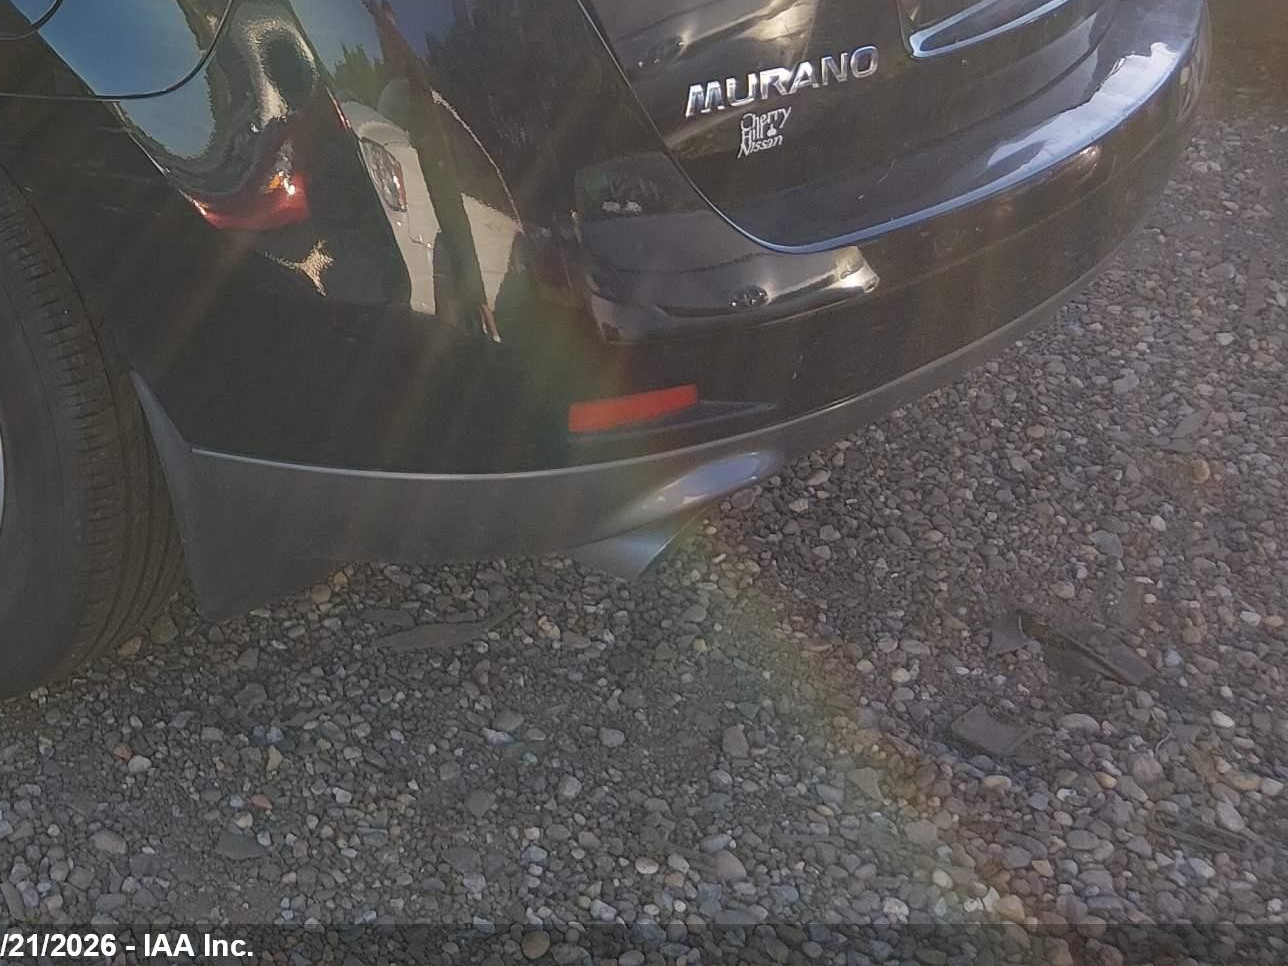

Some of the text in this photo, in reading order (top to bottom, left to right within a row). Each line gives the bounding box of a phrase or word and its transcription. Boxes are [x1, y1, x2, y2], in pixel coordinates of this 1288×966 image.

[685, 45, 879, 119] MURANO
[740, 106, 792, 131] Cherry
[736, 134, 783, 159] Nissan
[741, 124, 764, 148] Hill
